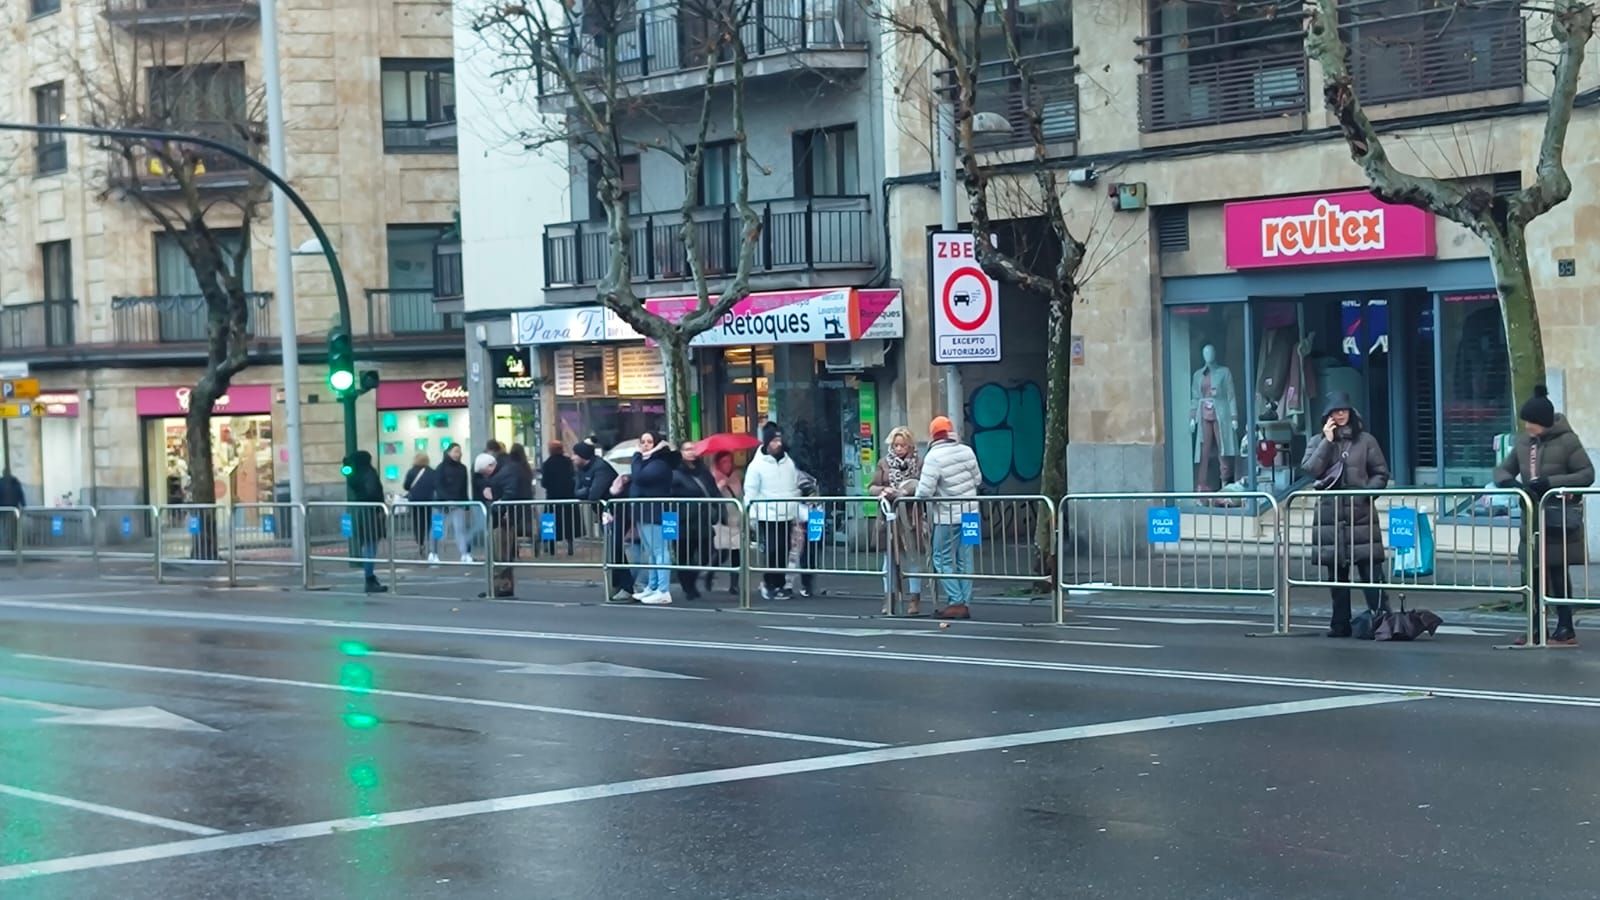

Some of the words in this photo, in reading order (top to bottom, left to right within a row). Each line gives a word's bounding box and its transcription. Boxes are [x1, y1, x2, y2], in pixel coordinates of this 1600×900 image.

[1262, 199, 1385, 257] revitex
[937, 241, 974, 259] ZBE
[520, 313, 571, 342] Para
[576, 309, 604, 338] Ti
[723, 310, 810, 341] Retoques
[952, 337, 985, 345] EXCEPTO
[941, 347, 995, 356] AUTORIZADOS
[1153, 527, 1172, 535] LOCAL
[1392, 527, 1413, 537] LOCAL
